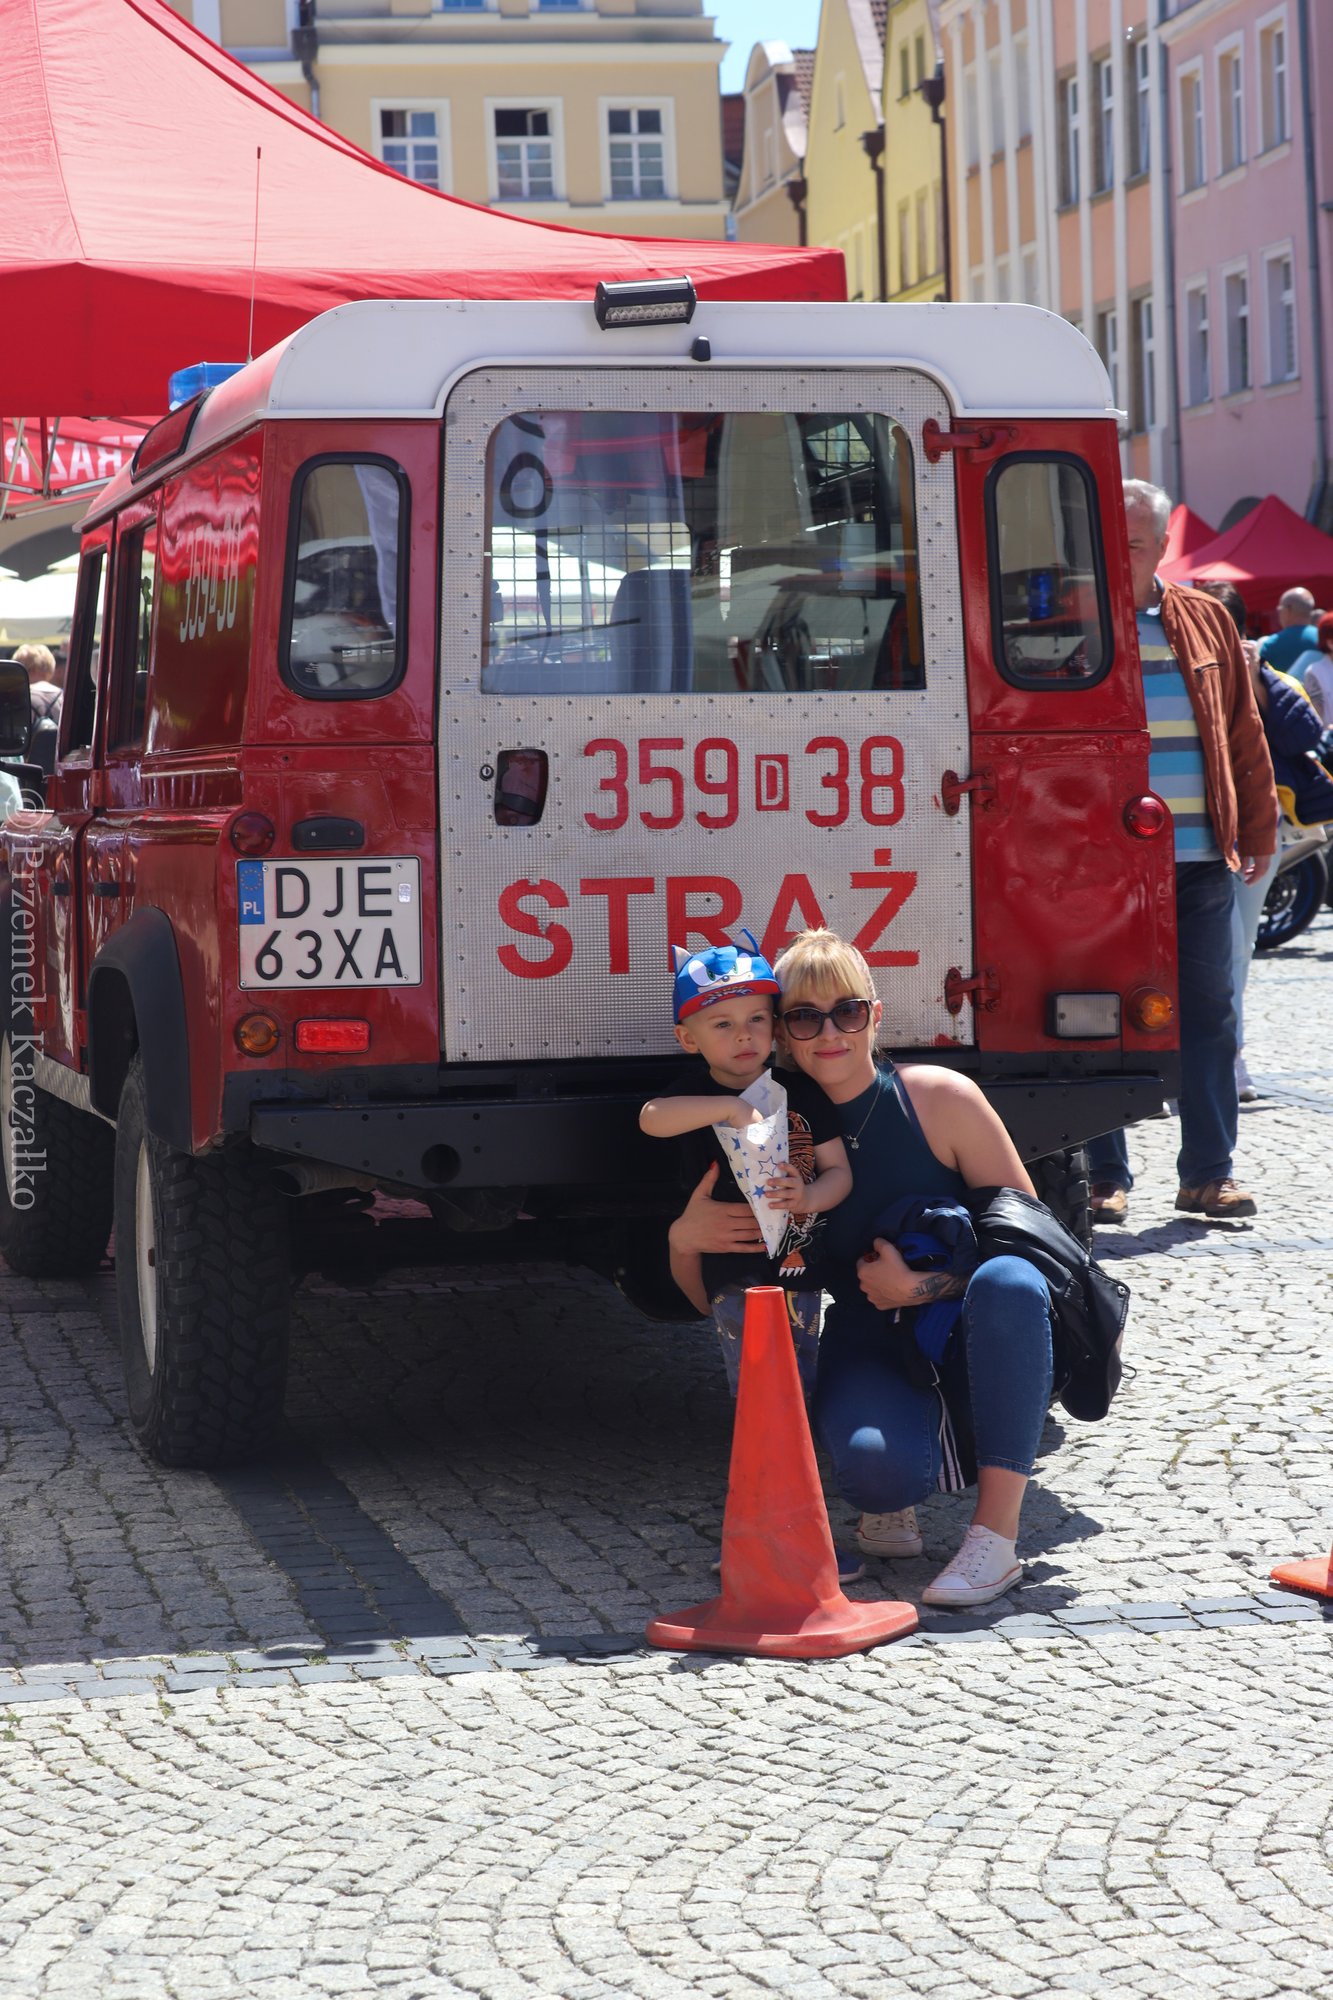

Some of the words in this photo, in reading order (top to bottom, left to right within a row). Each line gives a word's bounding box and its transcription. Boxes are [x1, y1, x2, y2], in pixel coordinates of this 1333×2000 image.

[583, 738, 739, 830] 359
[759, 757, 786, 808] D
[805, 735, 905, 827] 38
[243, 902, 261, 916] PL
[275, 866, 393, 919] DJE
[497, 848, 920, 979] STRAŻ
[255, 928, 403, 981] 63XA
